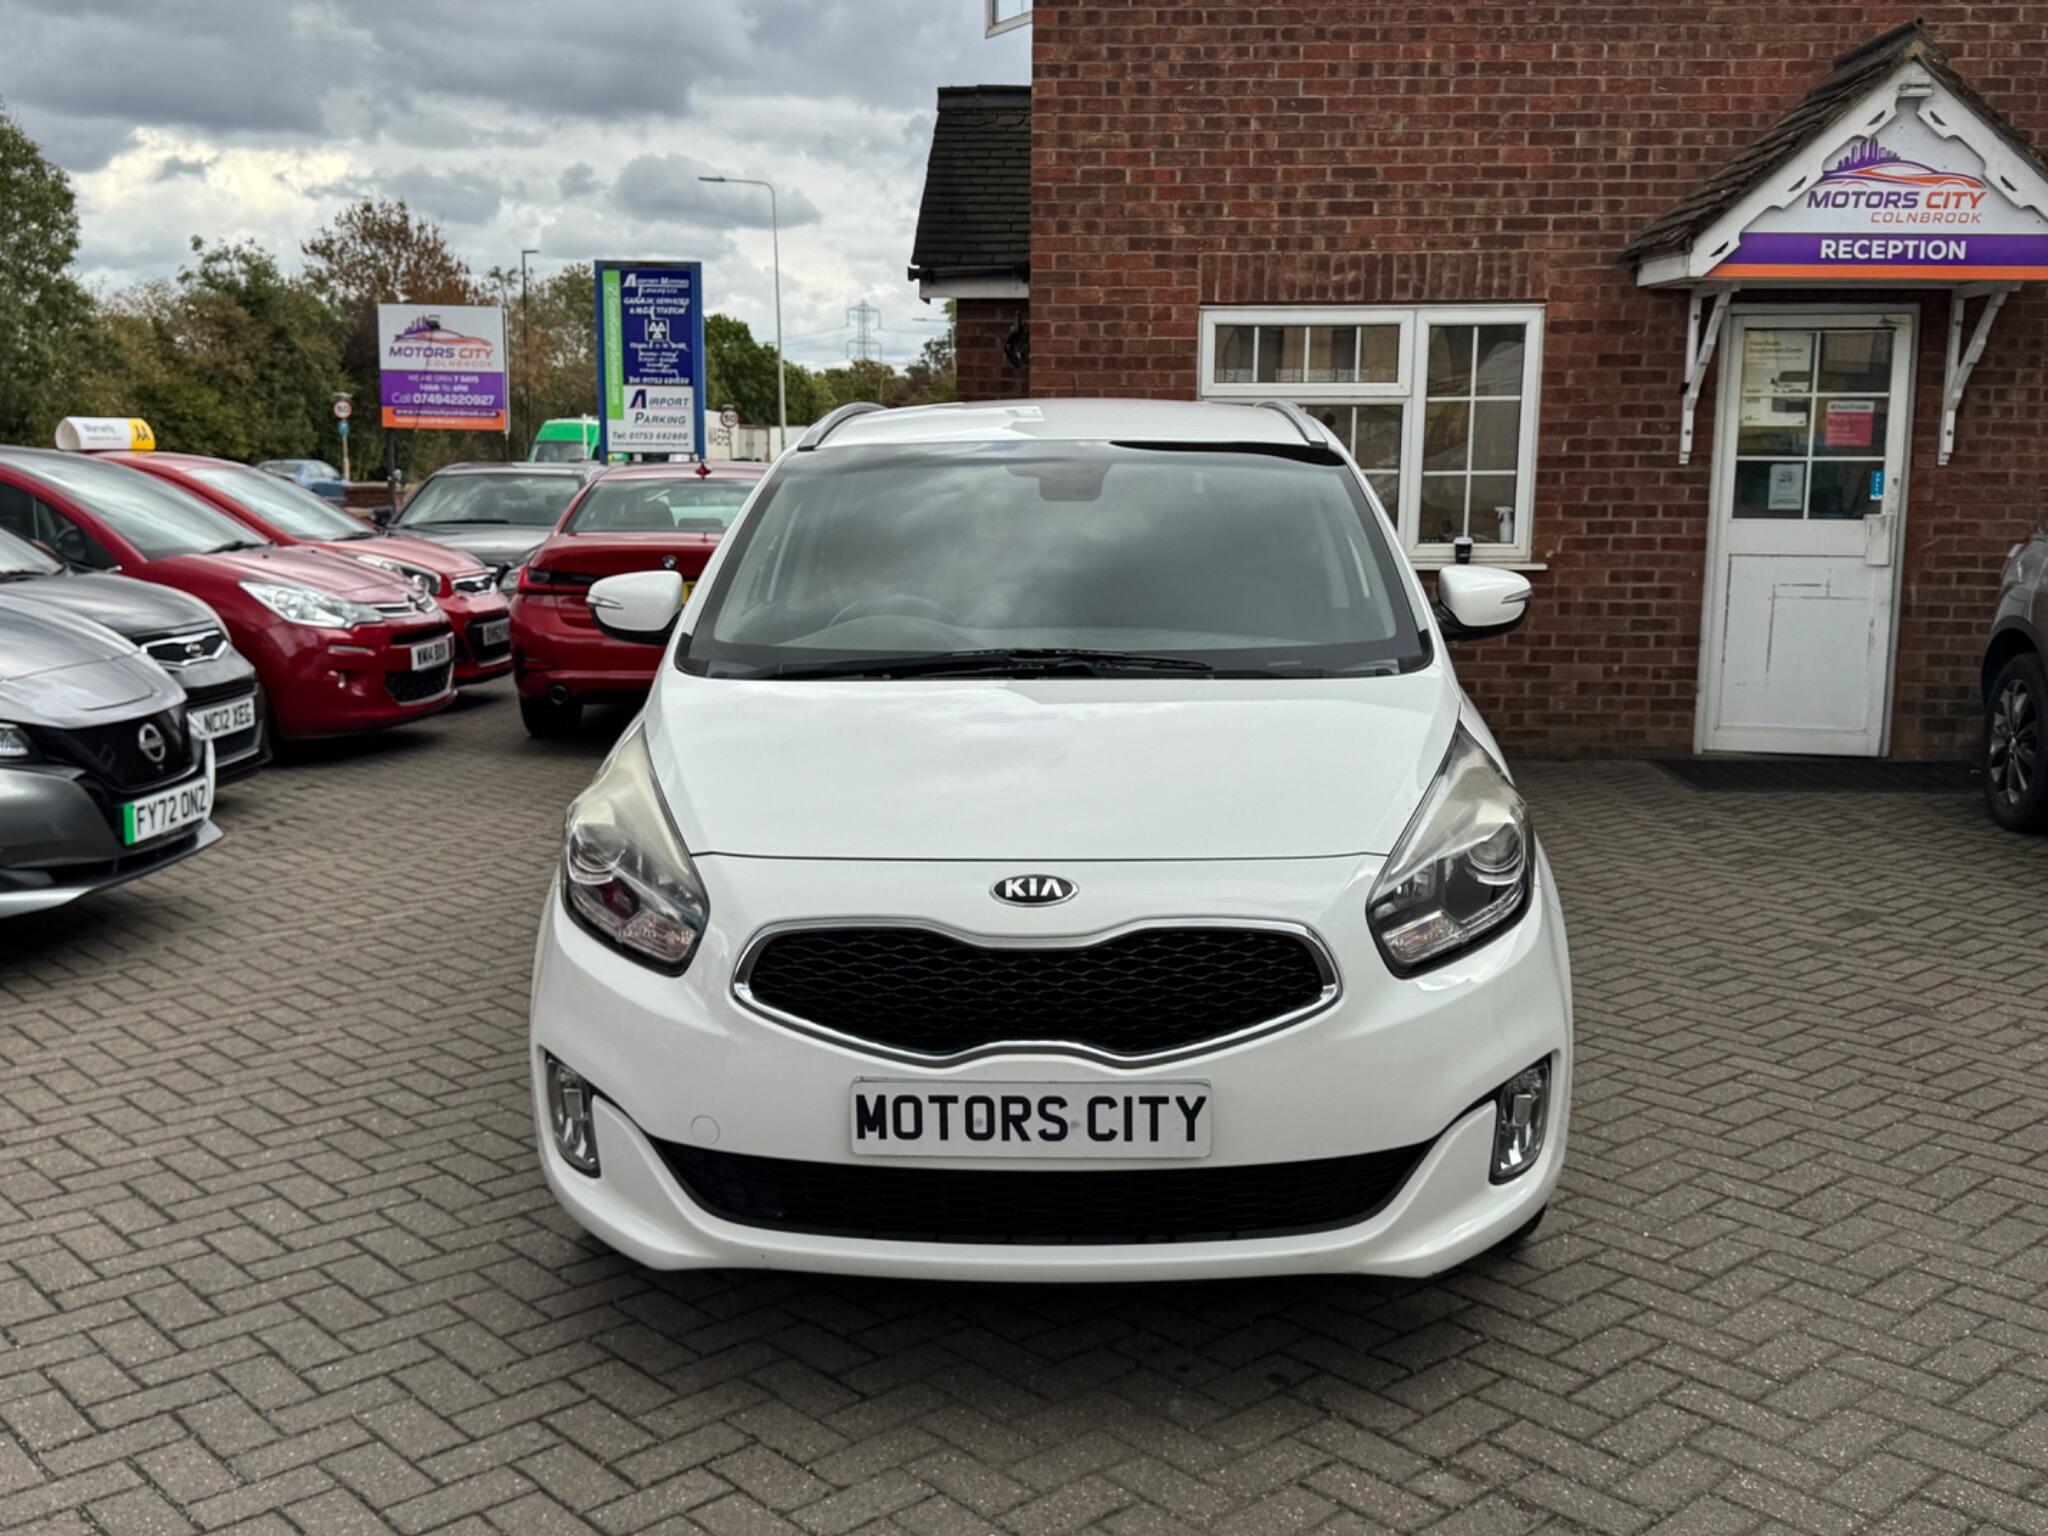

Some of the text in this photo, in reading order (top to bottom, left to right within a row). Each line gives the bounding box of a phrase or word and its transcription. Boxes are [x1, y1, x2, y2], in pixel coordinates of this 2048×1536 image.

[1807, 191, 1987, 210] MOTORS CITY
[1871, 212, 1981, 224] COLNBROOK
[1820, 240, 1966, 260] RECEPTION
[388, 346, 494, 359] MOTORS CITY
[391, 392, 412, 403] Call
[629, 389, 689, 409] AIRPORT
[634, 411, 687, 425] PARKING
[724, 414, 737, 422] 50
[204, 708, 230, 733] NC12
[137, 795, 177, 834] FY72
[1004, 878, 1063, 898] KIA
[855, 1094, 1207, 1142] MOTORS CITY
